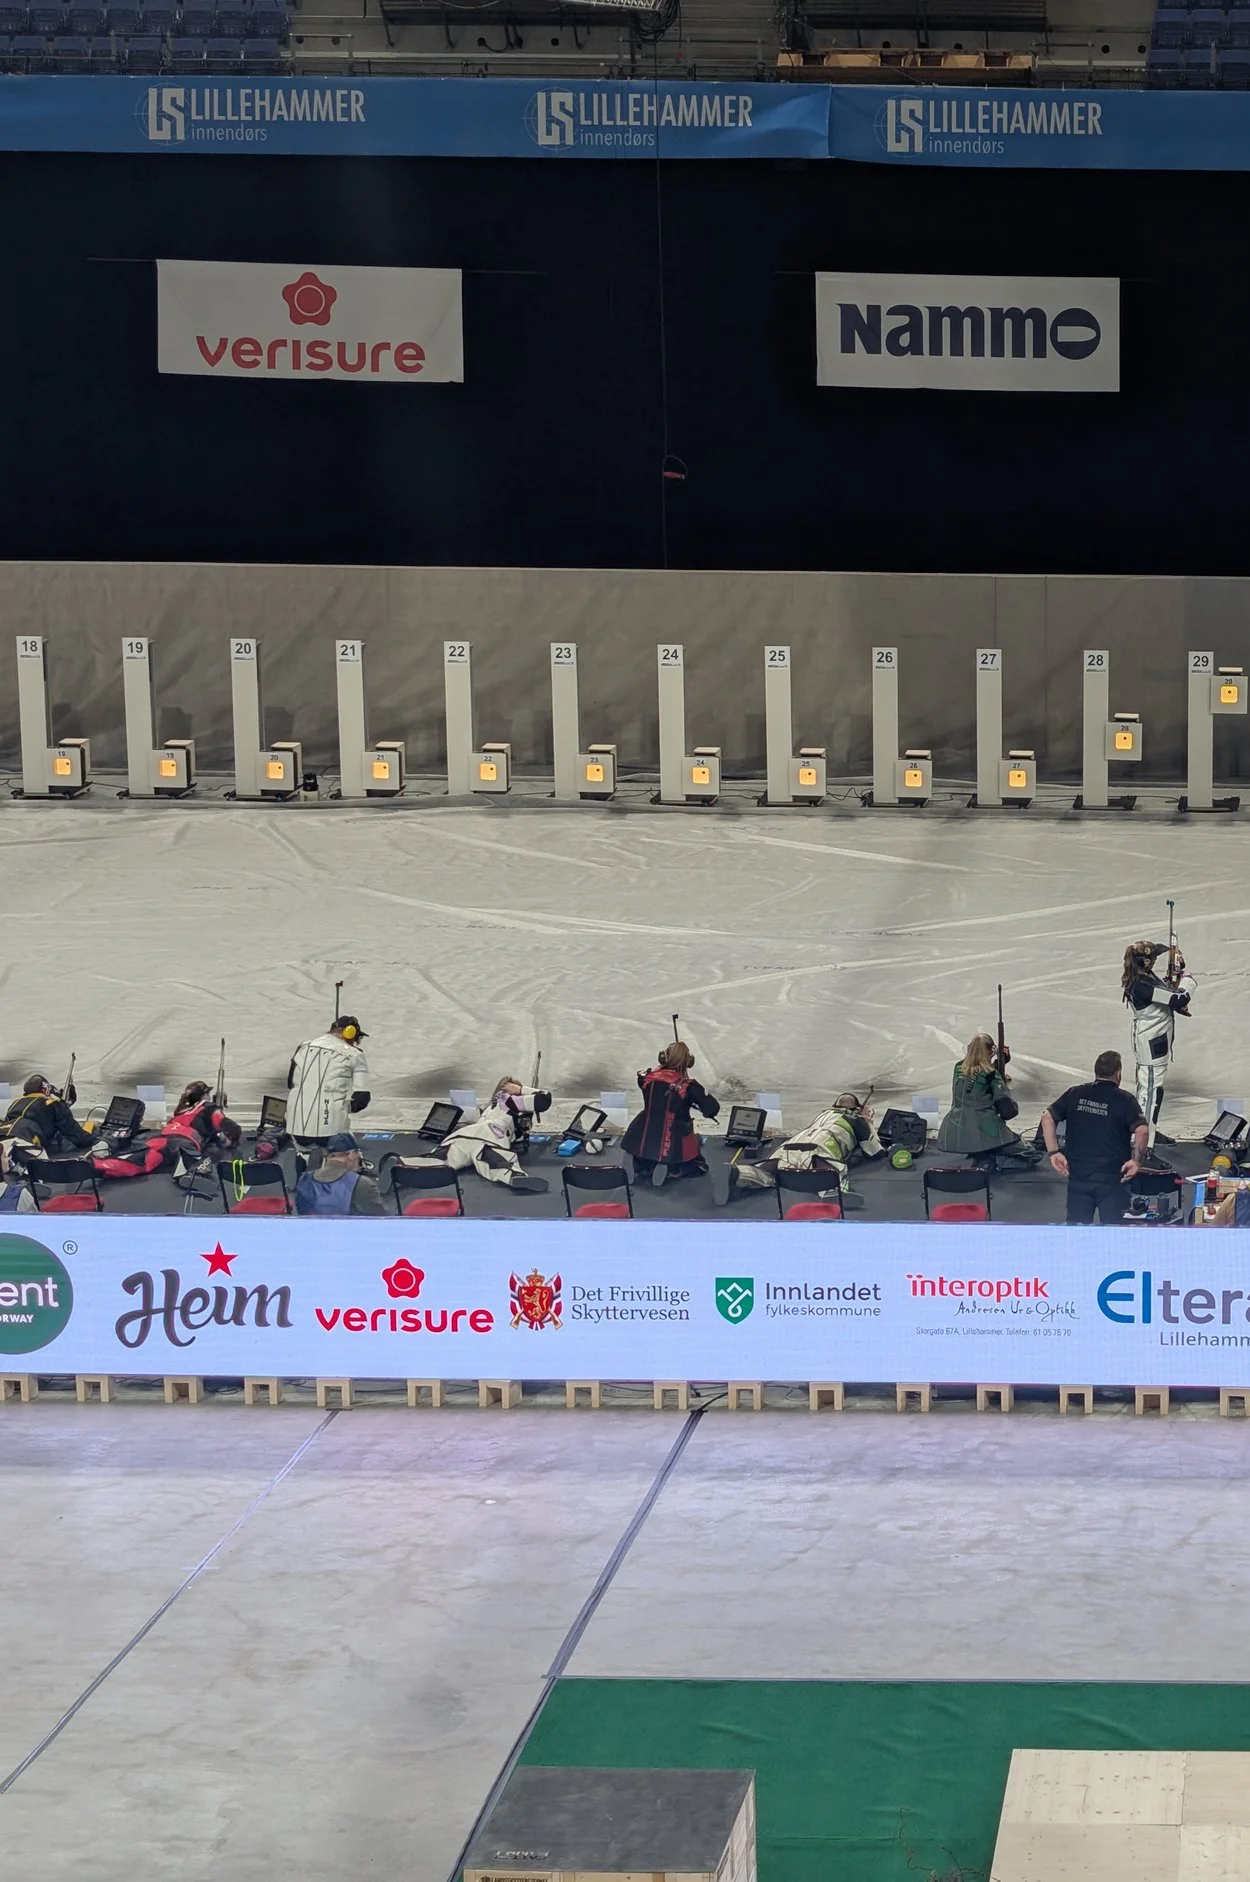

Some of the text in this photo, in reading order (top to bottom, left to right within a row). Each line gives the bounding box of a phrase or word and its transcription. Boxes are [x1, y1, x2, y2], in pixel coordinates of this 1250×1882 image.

[191, 89, 365, 124] LILLEHAMMER
[580, 93, 757, 129] LILLEHAMMER
[930, 101, 1102, 137] LILLEHAMMER
[192, 122, 270, 141] innendørs
[580, 127, 658, 151] innendørs
[930, 135, 1007, 153] innendørs
[837, 304, 1101, 360] Nammo
[195, 336, 426, 374] verisure
[22, 641, 37, 652] 18
[128, 642, 143, 653] 19
[236, 643, 251, 654] 20
[341, 645, 355, 656] 21
[449, 646, 464, 656] 22
[556, 647, 571, 658] 23
[663, 649, 678, 660] 24
[770, 650, 785, 661] 25
[877, 652, 892, 663] 26
[981, 654, 996, 664] 27
[1088, 655, 1103, 666] 28
[1193, 656, 1208, 666] 29
[375, 753, 385, 761] 21
[572, 1286, 689, 1307] Det Frivillige
[767, 1283, 881, 1300] Innlandet
[115, 1268, 294, 1348] Heim
[572, 1302, 689, 1323] Skyttervesen
[766, 1300, 881, 1317] fylkeskommune
[0, 1314, 34, 1323] RWAY
[315, 1308, 494, 1333] verisure
